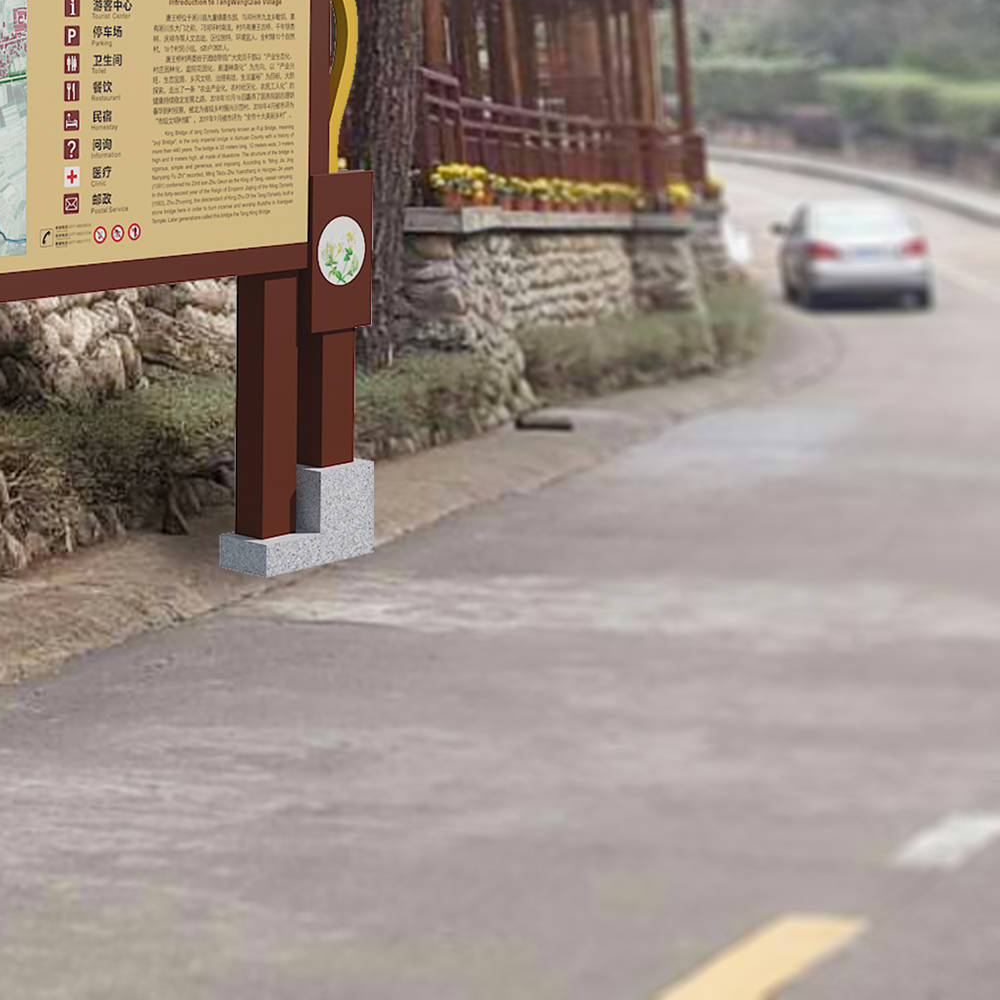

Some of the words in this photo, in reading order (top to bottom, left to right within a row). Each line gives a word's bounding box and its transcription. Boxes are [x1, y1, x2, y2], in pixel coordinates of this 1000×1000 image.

[92, 0, 133, 12] 游客中心
[93, 25, 123, 38] 停车场
[92, 54, 123, 67] 卫生间
[93, 80, 113, 94] 餐饮
[92, 110, 112, 123] 民宿
[92, 138, 112, 151] 问询
[92, 165, 112, 179] 医疗
[92, 193, 112, 205] 邮政
